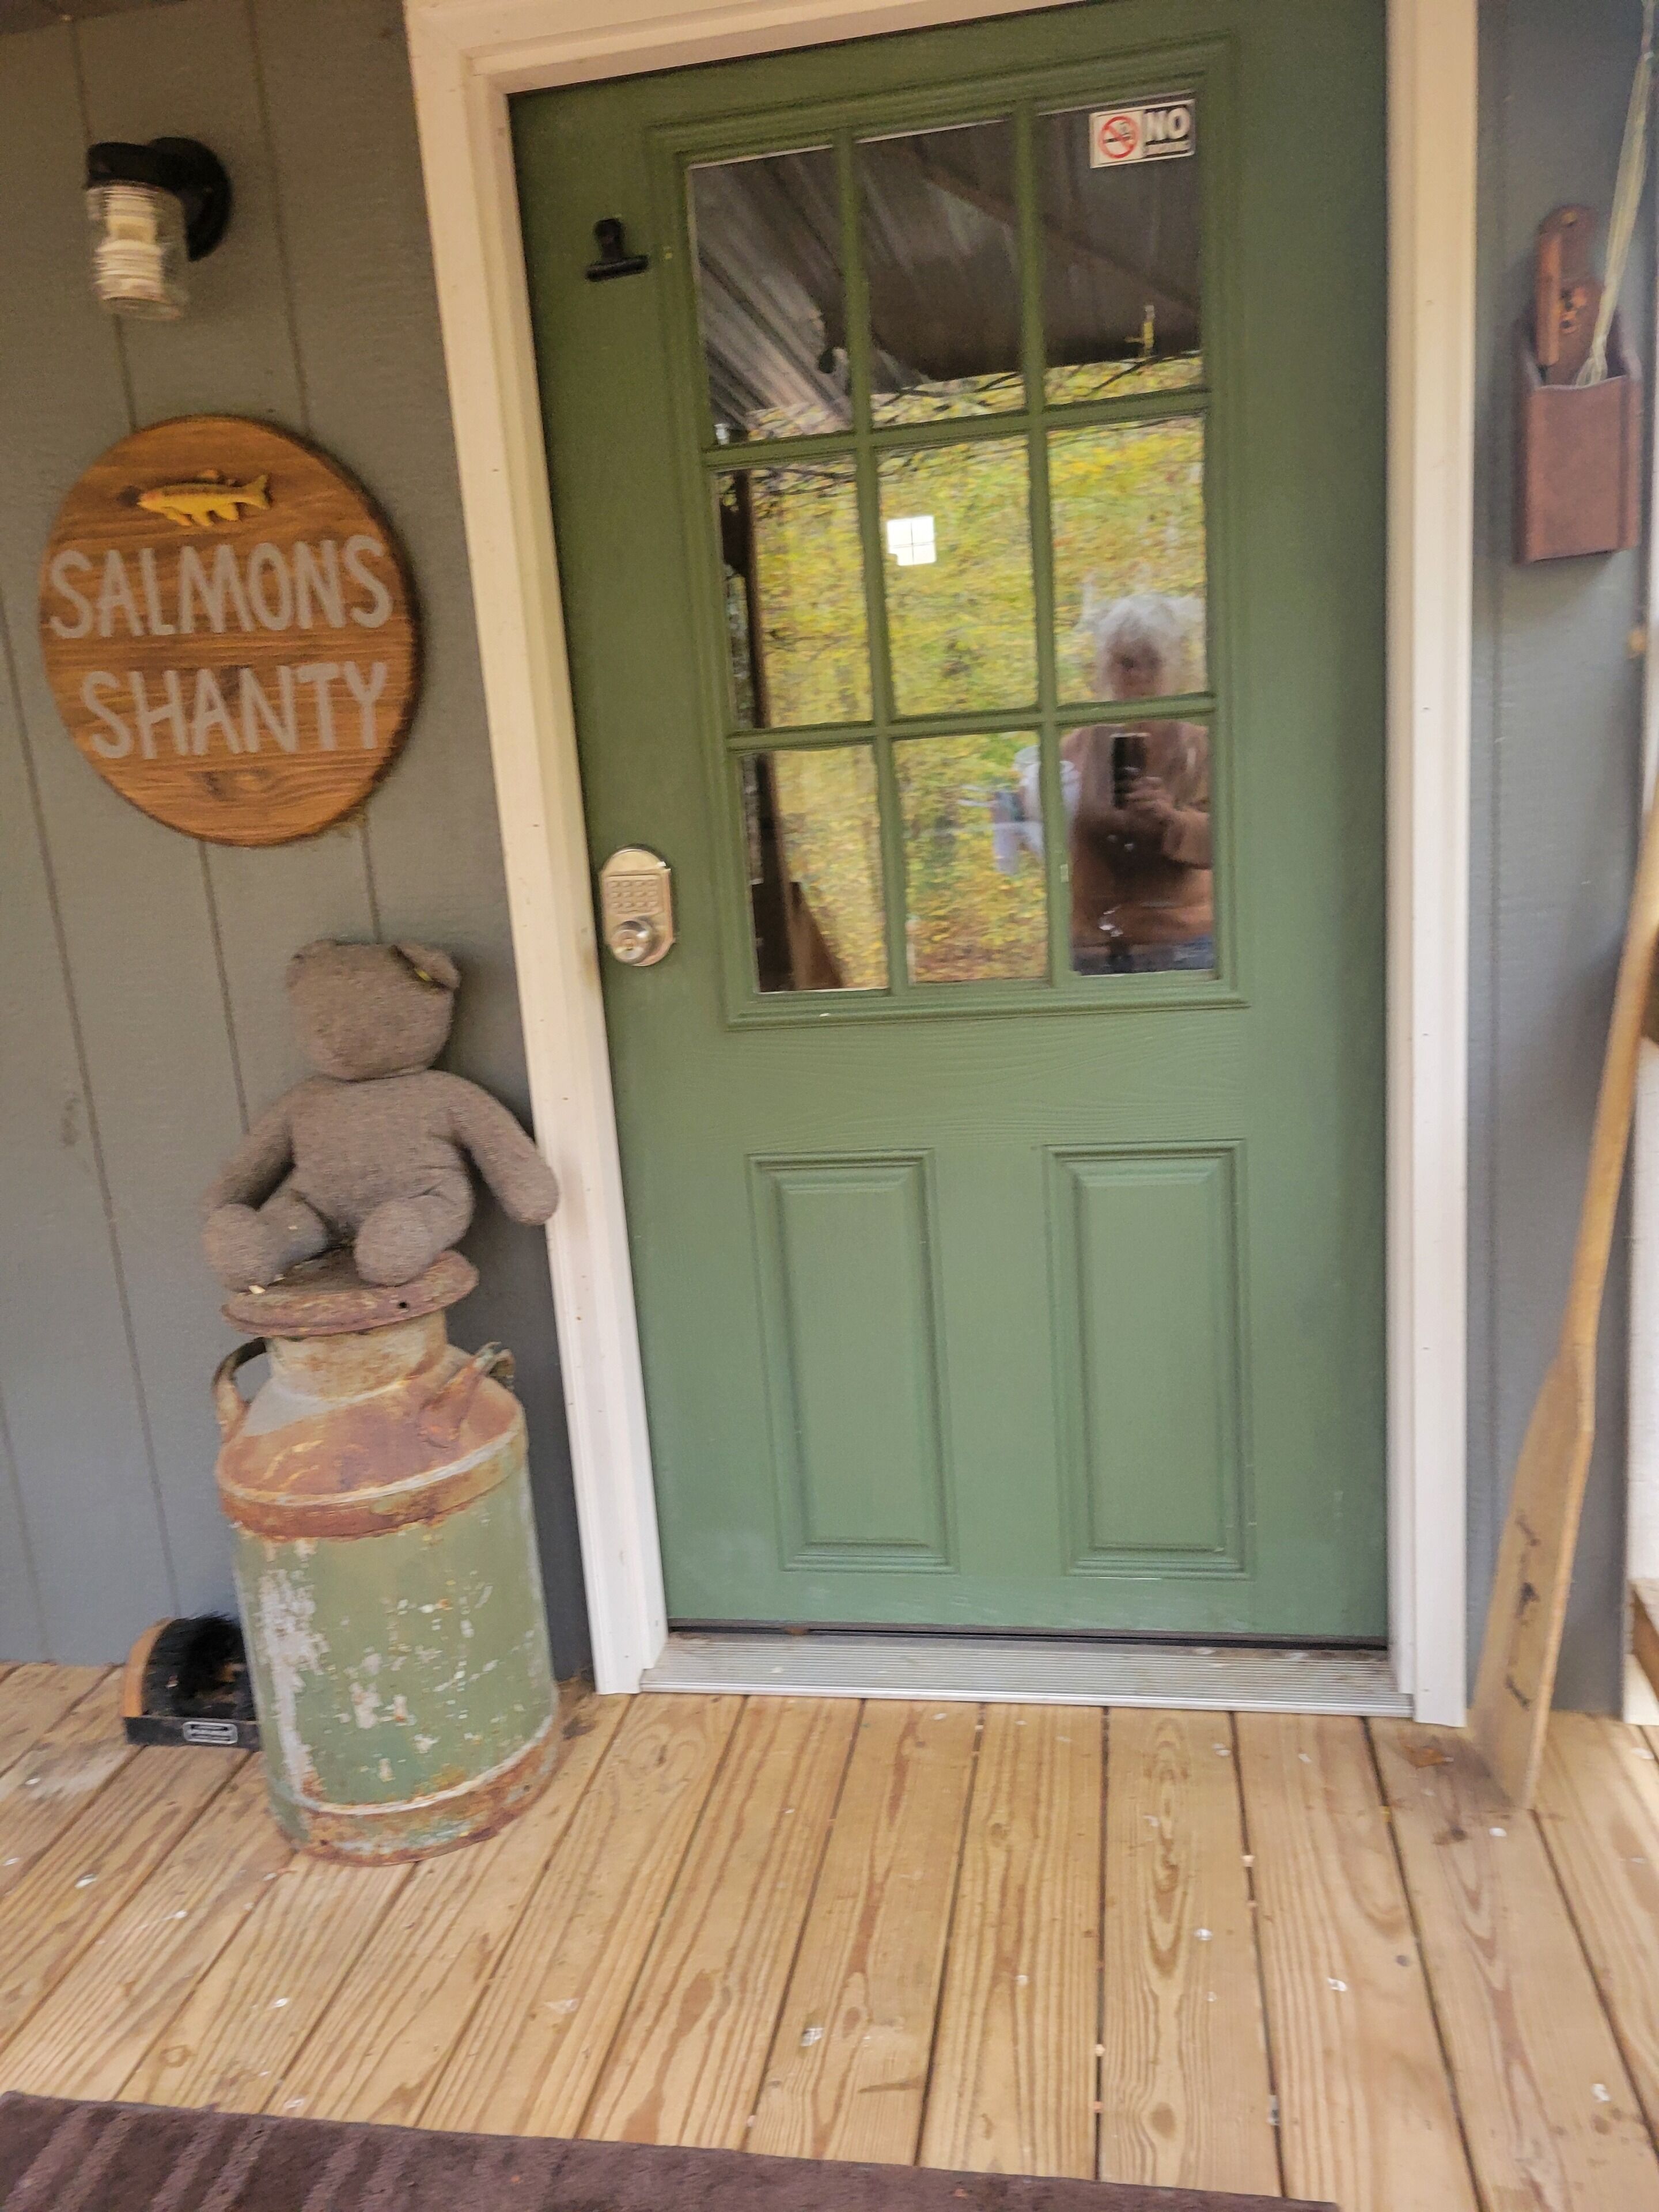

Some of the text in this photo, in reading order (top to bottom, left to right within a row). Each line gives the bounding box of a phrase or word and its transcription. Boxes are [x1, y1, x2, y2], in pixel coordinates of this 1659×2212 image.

[1146, 107, 1190, 141] NO
[50, 535, 393, 638] SALMONS
[82, 661, 388, 759] SHANTY
